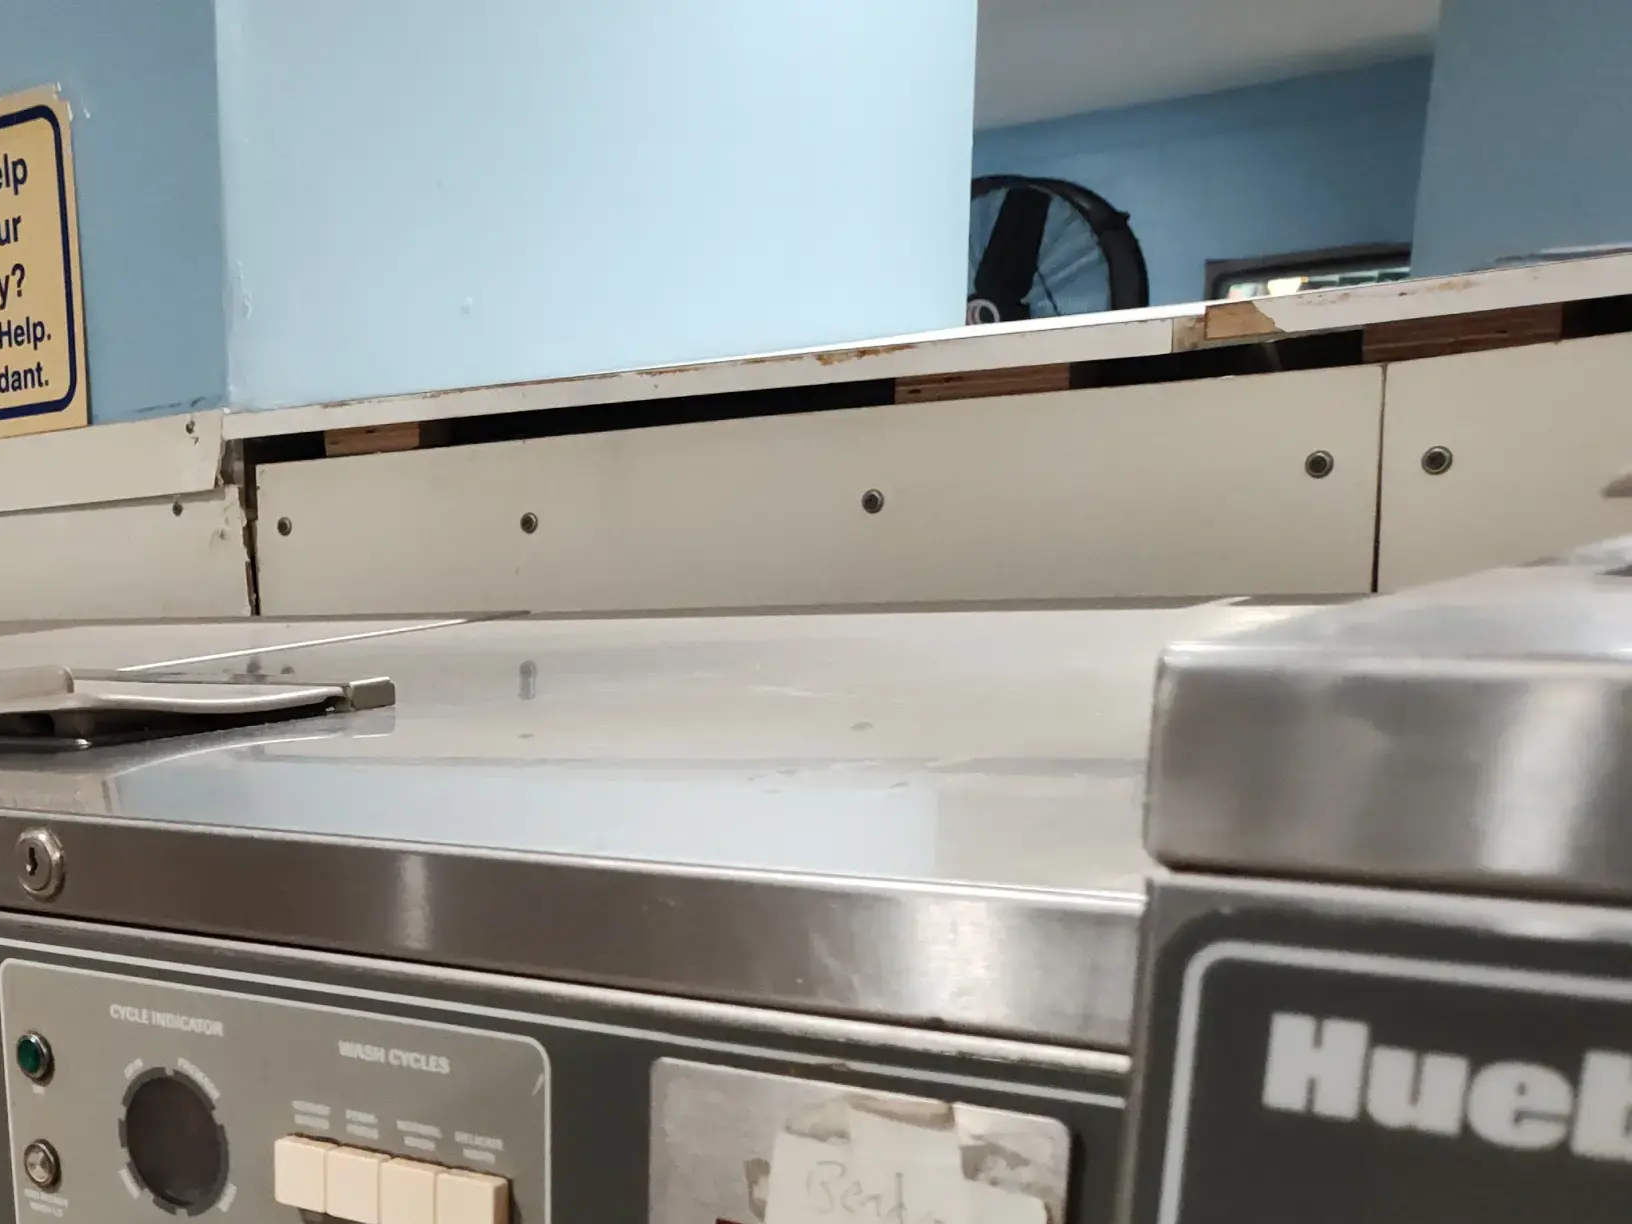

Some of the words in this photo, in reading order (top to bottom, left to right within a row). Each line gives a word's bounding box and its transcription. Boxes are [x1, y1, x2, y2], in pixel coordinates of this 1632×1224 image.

[110, 1004, 149, 1024] CYCLE
[151, 1010, 224, 1037] INDICATOR
[338, 1039, 384, 1063] WASH
[388, 1048, 450, 1074] CYCLES
